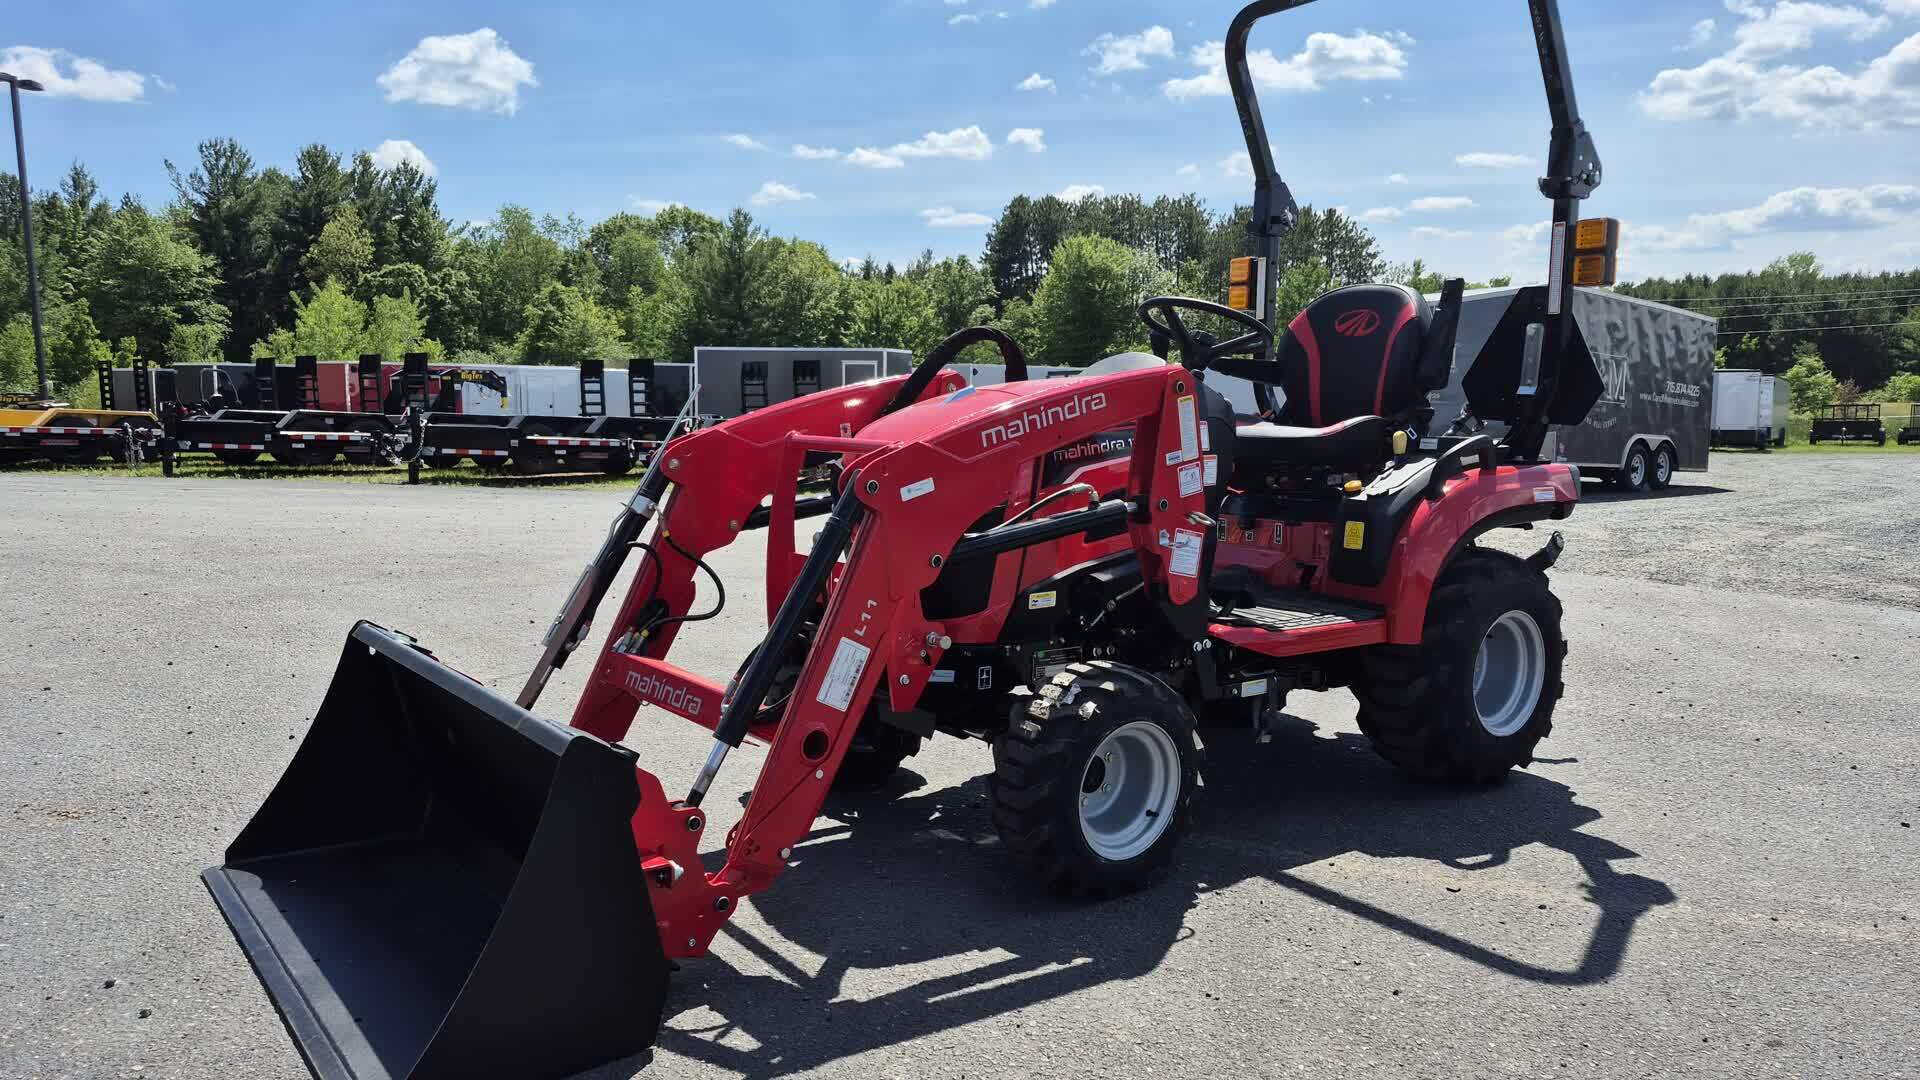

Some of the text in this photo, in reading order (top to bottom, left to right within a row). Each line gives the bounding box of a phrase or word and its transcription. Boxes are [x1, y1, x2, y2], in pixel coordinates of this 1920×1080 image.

[981, 392, 1107, 448] mahindra
[1053, 439, 1125, 461] mahindra
[854, 599, 878, 637] L11
[625, 670, 702, 716] mahindra
